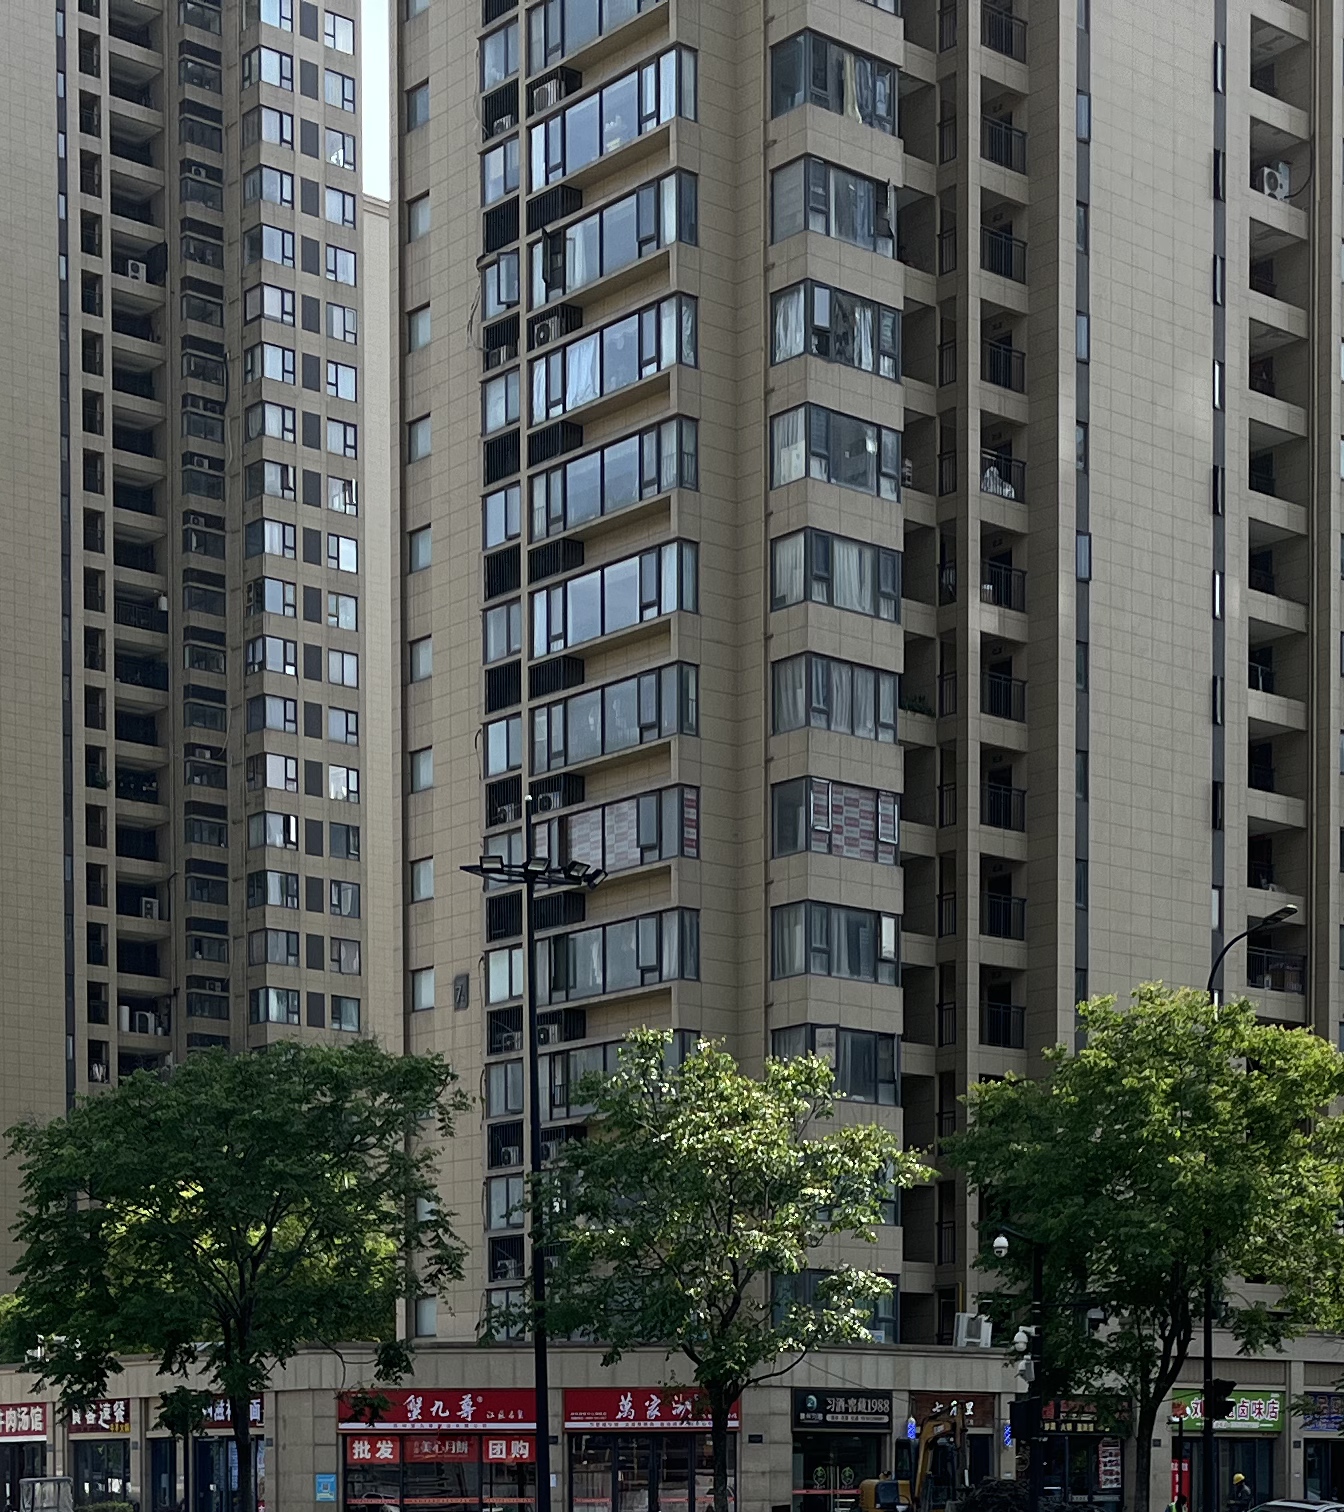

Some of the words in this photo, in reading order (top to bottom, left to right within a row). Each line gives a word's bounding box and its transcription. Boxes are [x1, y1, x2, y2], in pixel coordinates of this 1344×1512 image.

[403, 1393, 477, 1421] 蟹九尊
[1190, 1396, 1280, 1422] 刘卤味店
[352, 1440, 394, 1459] 批发
[488, 1440, 530, 1459] 团购
